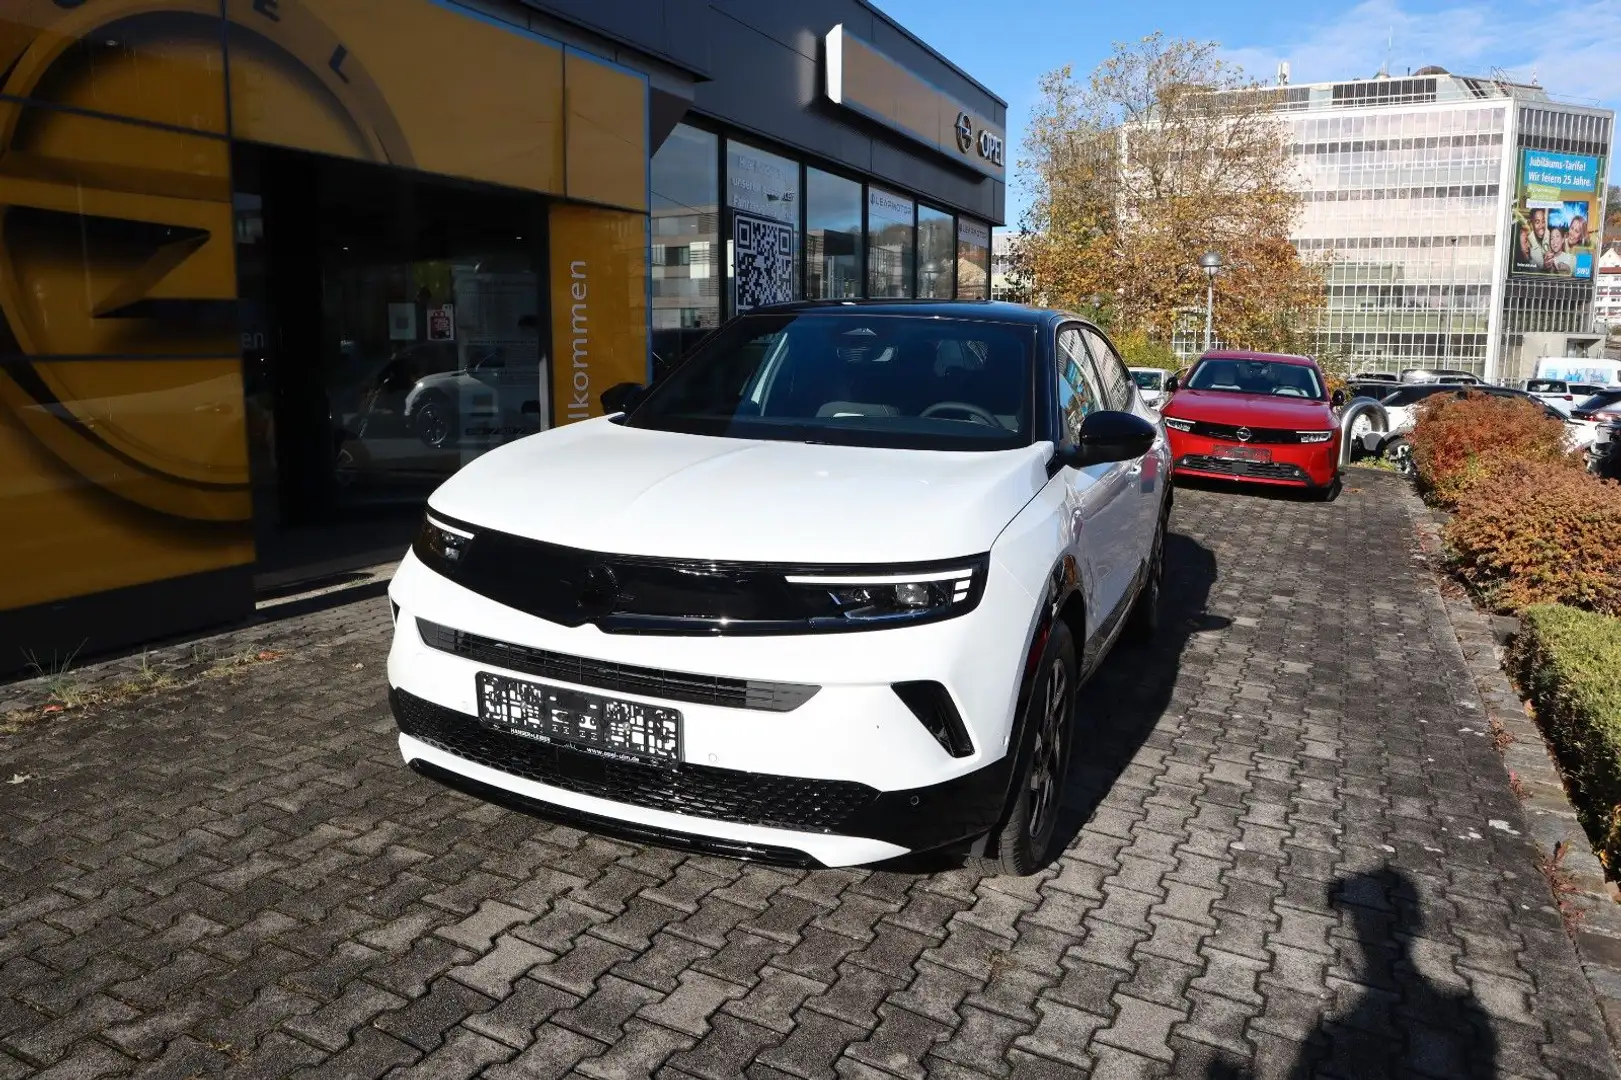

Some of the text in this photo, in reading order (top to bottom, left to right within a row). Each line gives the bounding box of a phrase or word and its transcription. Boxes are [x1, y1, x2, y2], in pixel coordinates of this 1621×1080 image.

[978, 129, 1004, 167] OPEL
[1529, 156, 1586, 172] Jubiläums-Tarife!
[1529, 171, 1591, 187] Wir feiern 25 Jahre.
